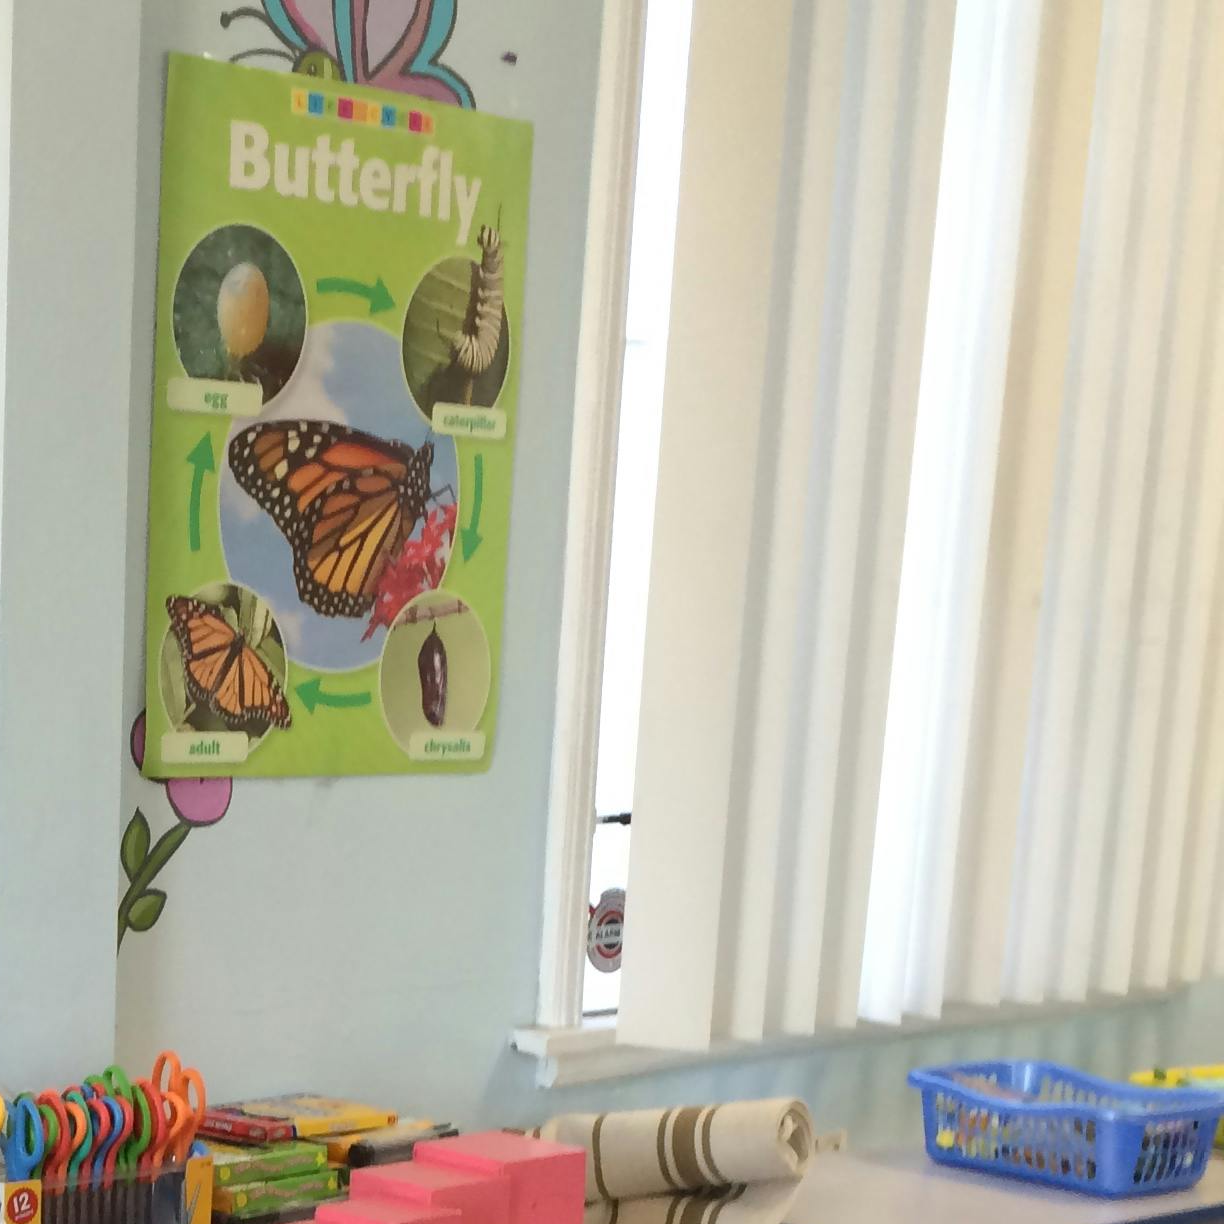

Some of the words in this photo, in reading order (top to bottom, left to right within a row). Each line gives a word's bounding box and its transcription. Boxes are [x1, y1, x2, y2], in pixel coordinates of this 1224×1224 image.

[230, 120, 482, 246] Butterfly
[189, 740, 220, 755] adult
[13, 1191, 31, 1214] 12
